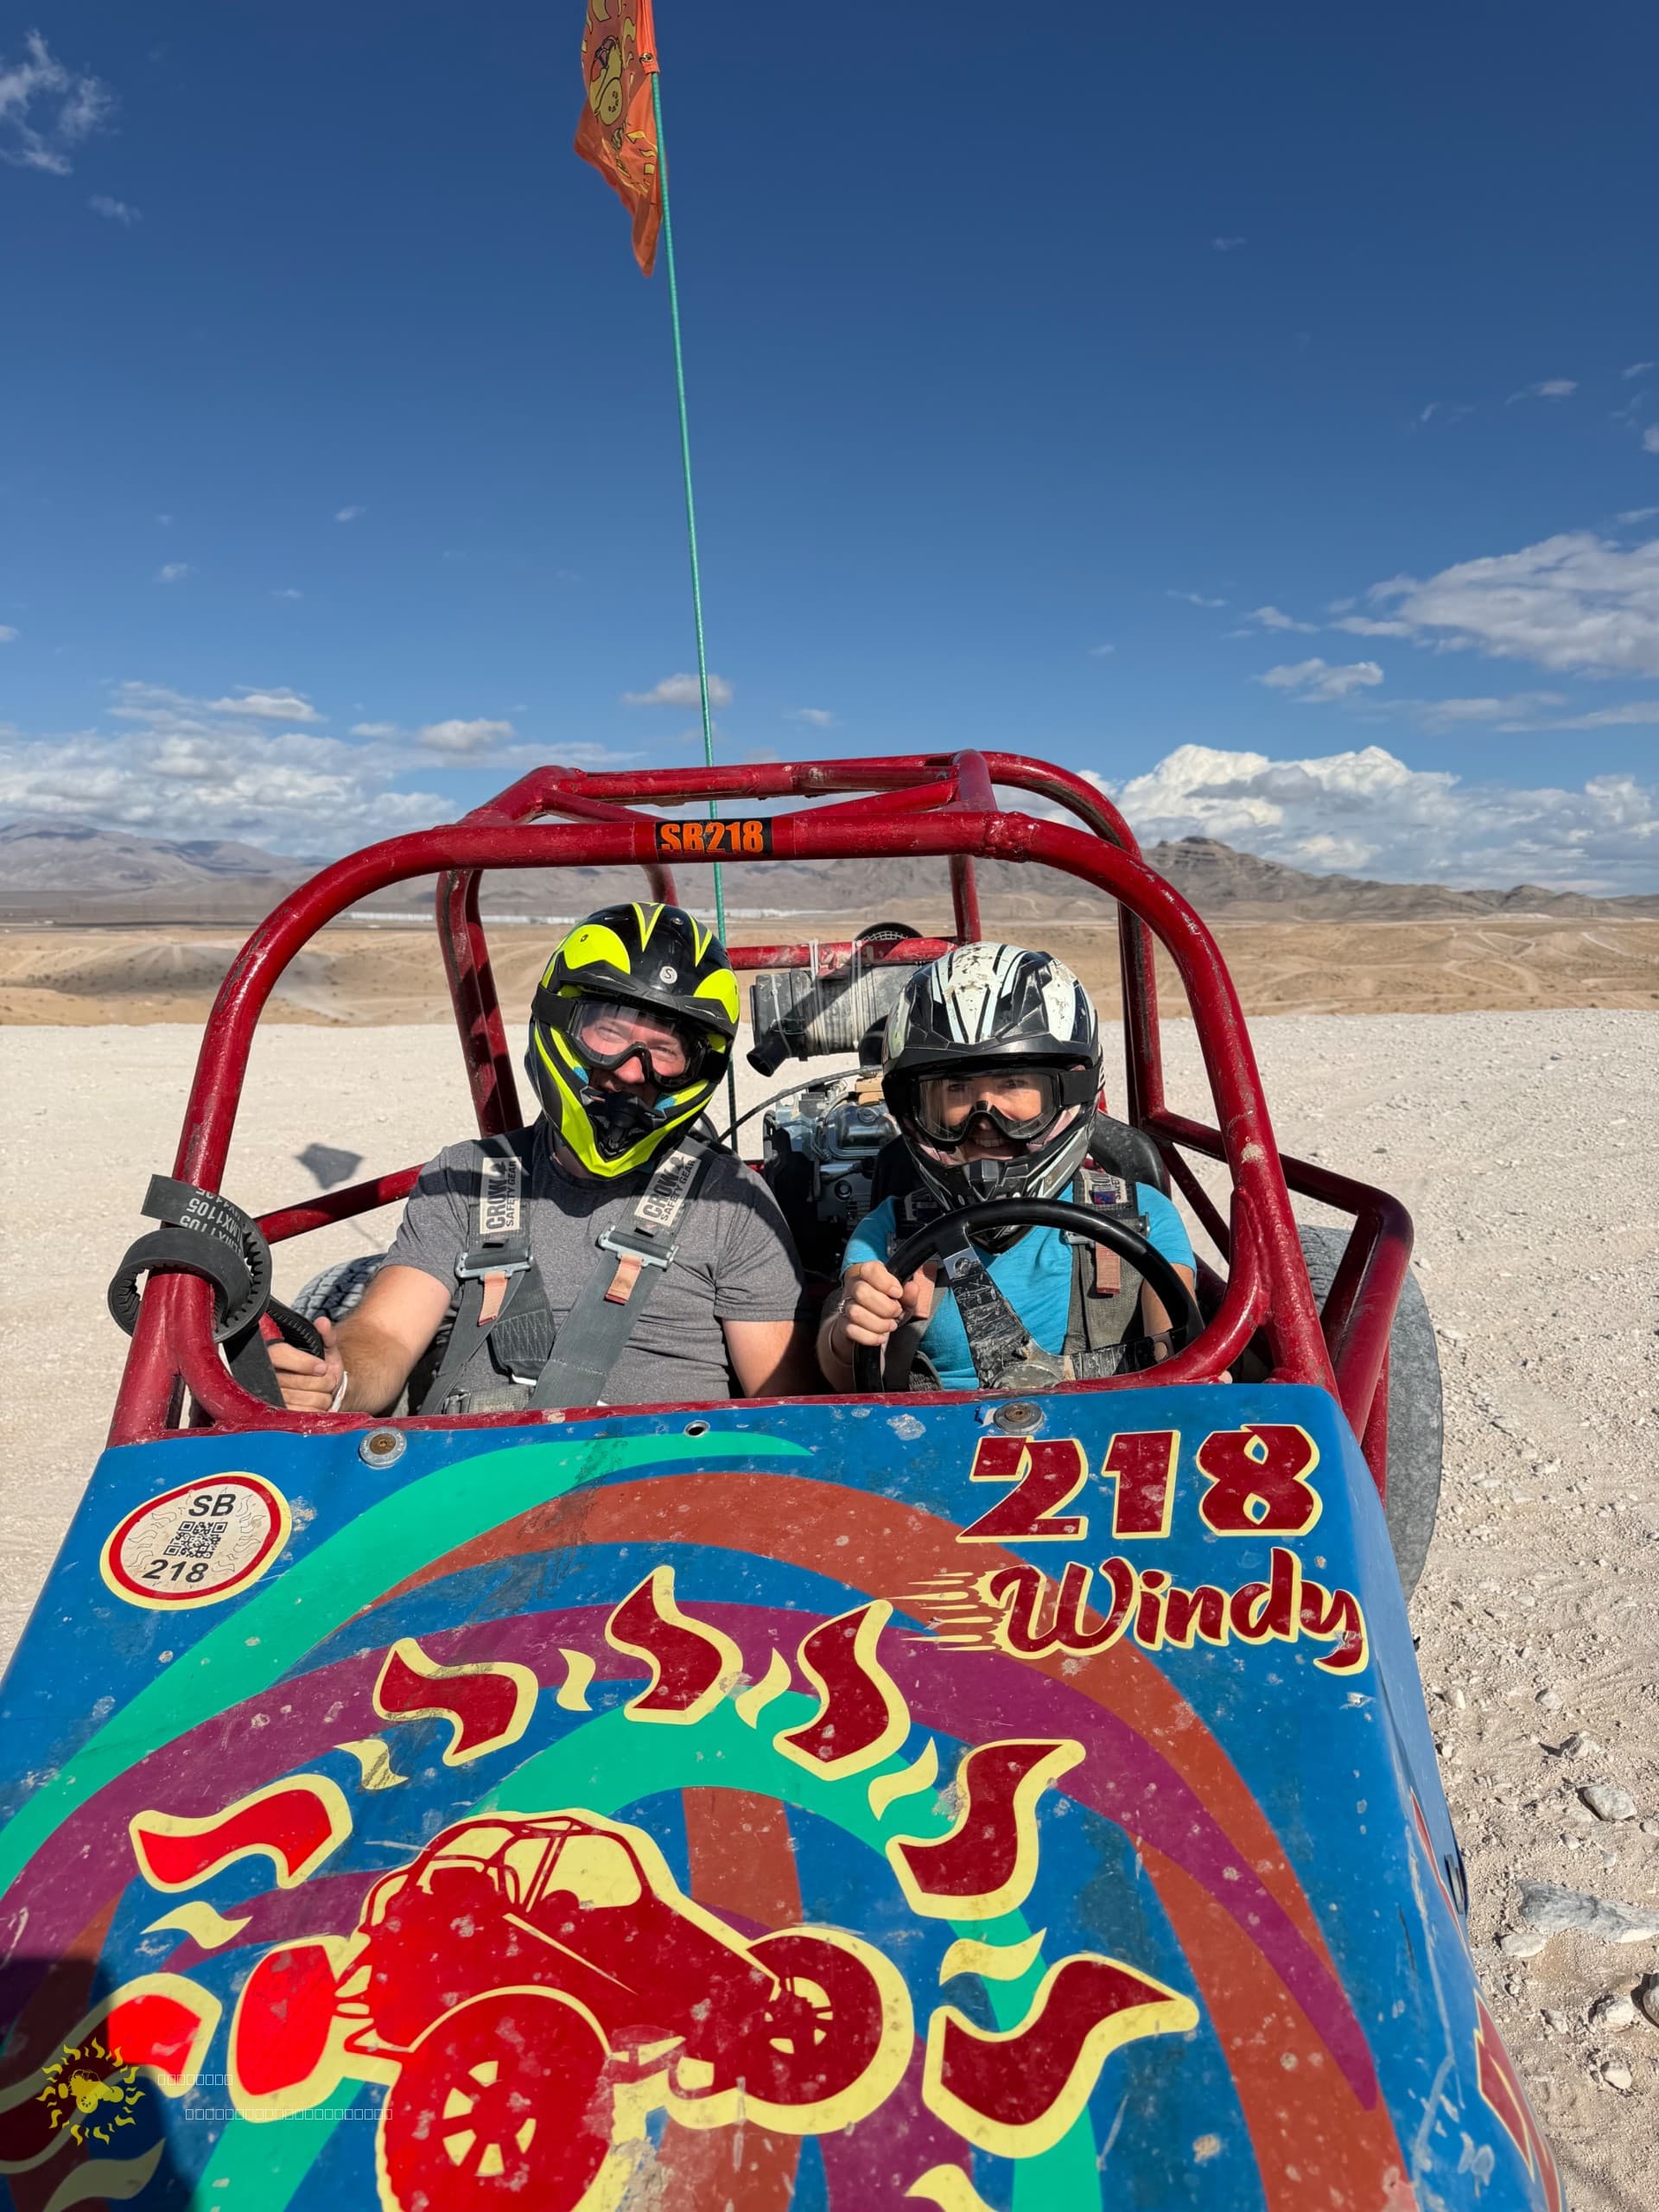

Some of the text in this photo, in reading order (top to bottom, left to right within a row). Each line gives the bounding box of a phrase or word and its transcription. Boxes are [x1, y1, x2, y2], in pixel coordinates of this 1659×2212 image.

[660, 820, 764, 853] SR218
[486, 1179, 507, 1230] CROW
[505, 1160, 517, 1227] SAFETY GEAR
[643, 1168, 679, 1218] CROW
[660, 1160, 696, 1221] SAFETY GEAR
[188, 1493, 237, 1517] SB
[956, 1423, 1323, 1543] 218
[142, 1559, 209, 1583] 218
[975, 1547, 1369, 1676] Windy
